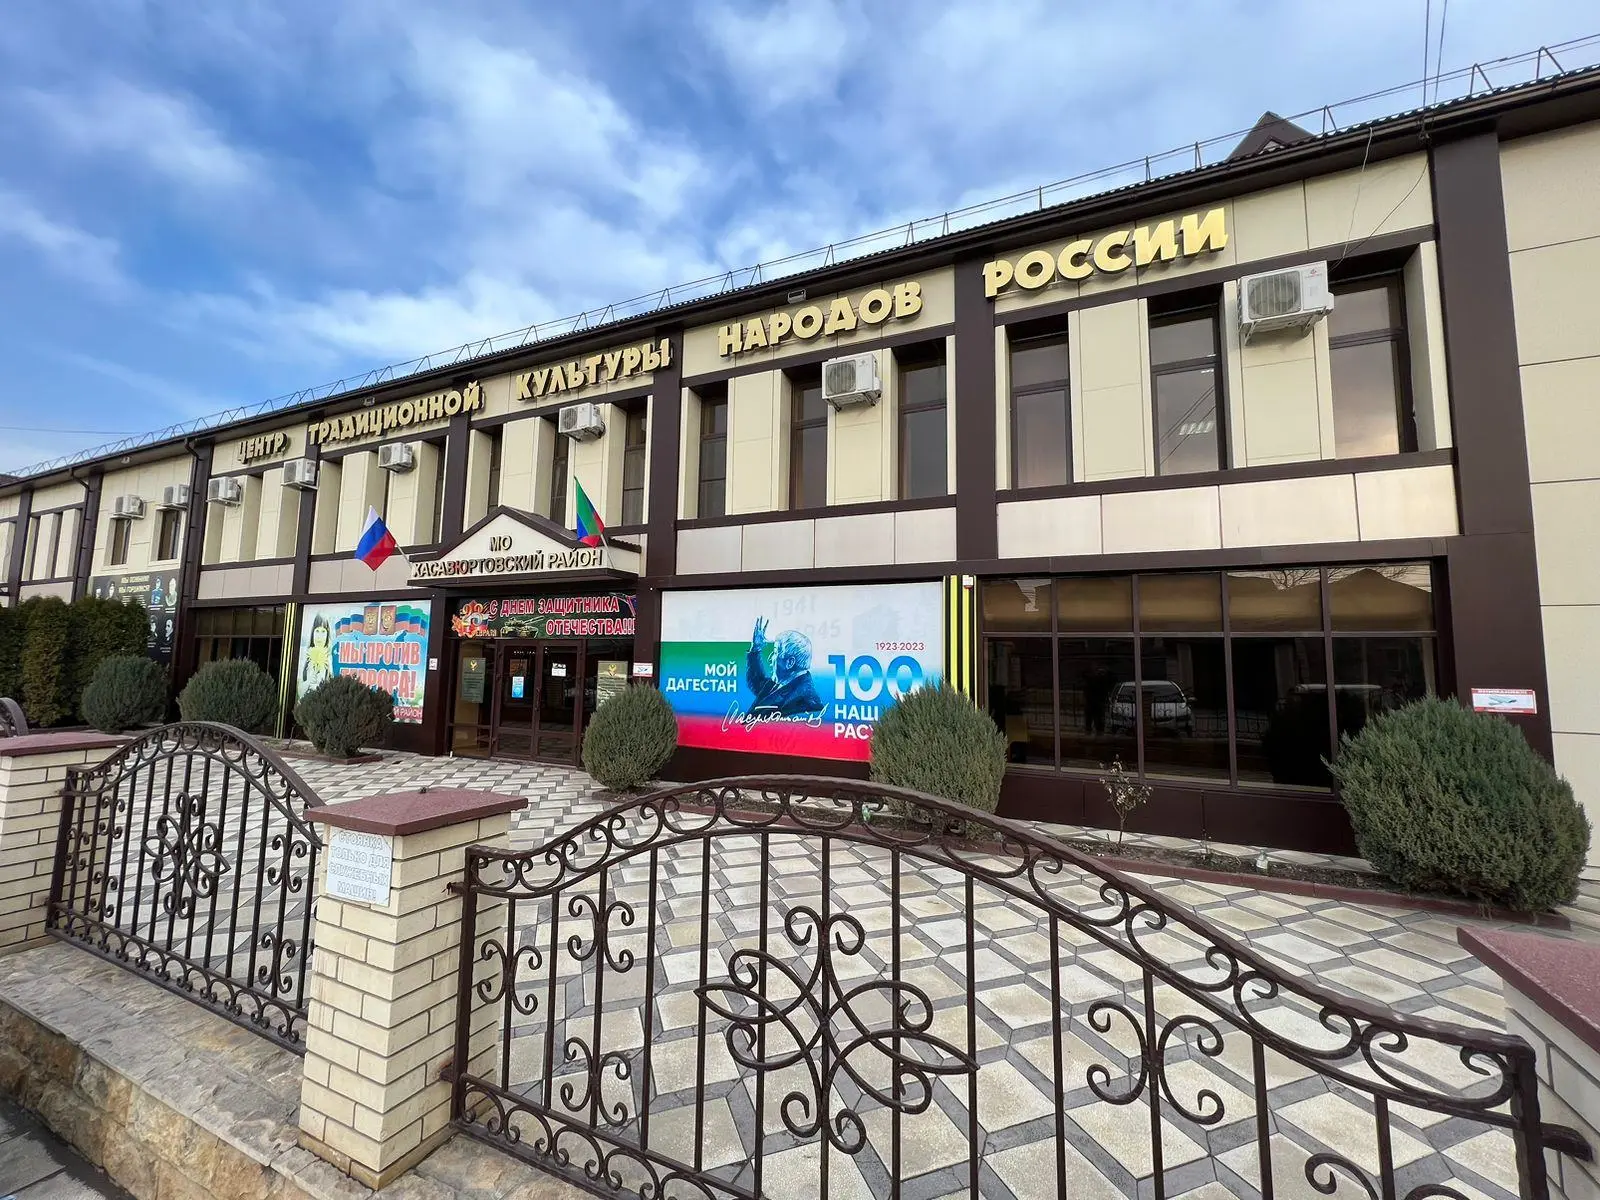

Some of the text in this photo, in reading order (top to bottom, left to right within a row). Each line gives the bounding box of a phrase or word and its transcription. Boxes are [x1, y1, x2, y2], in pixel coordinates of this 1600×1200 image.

[237, 207, 1229, 464] ЦЕНТР ТРАДИЦИОННОЙ КУЛЬТУРЫ НАРОДОВ РОССИИ
[490, 535, 513, 551] МО
[412, 547, 603, 578] ХАСАВЮРТОВСКИЙ РАЙОН
[490, 596, 620, 617] С ДНЕМ ЗАЩИТНИКА
[546, 617, 635, 636] ОТЕЧЕСТВА!!!
[339, 641, 364, 664] МЫ
[366, 642, 420, 666] ПРОТИВ
[704, 661, 737, 677] МОЙ
[828, 654, 923, 702] 100
[665, 678, 737, 693] ДАГЕСТАН
[834, 722, 874, 740] РАС
[339, 830, 383, 851] СТОЯНКА
[331, 846, 390, 870] ТОЛЬКО ДЛЯ
